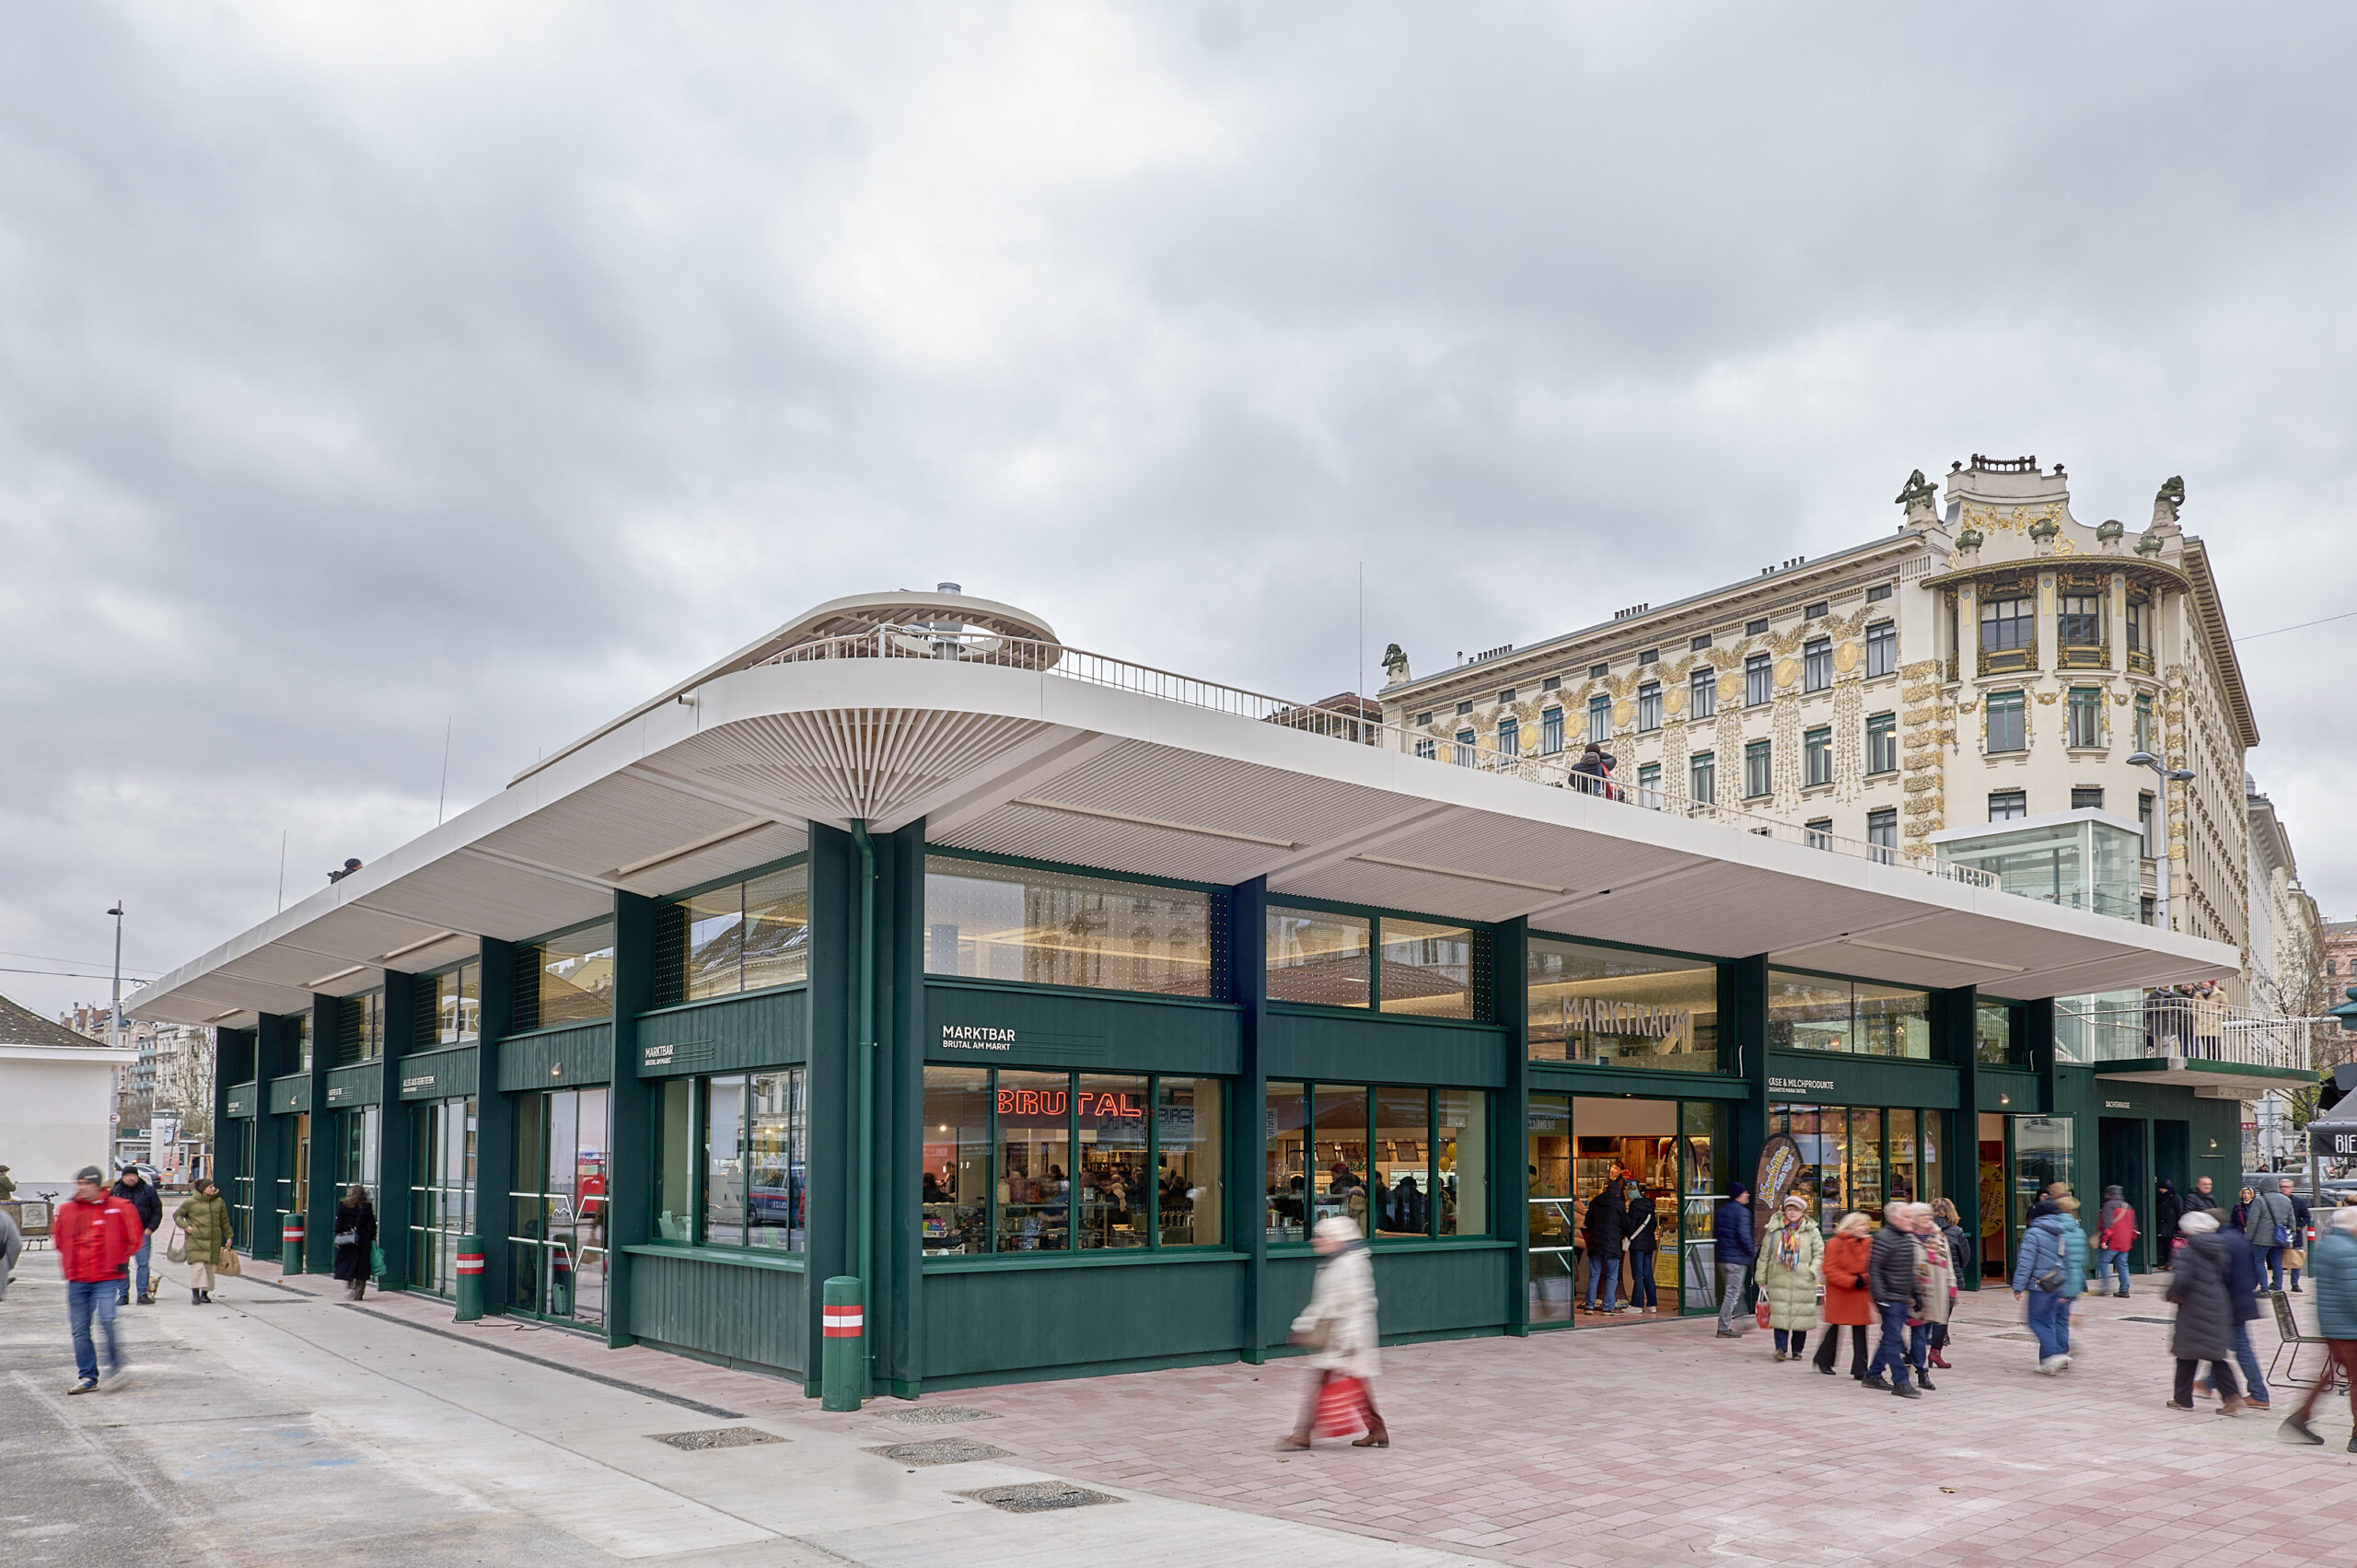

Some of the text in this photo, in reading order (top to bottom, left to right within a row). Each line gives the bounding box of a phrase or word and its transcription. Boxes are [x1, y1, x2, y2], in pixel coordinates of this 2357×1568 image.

[1562, 996, 1689, 1040] MARKTRAUM
[943, 1025, 1016, 1042] MARKTBAR
[645, 1045, 673, 1058] MARKTBAR
[943, 1040, 1011, 1051] BRUTAL AM MARKT
[1782, 1078, 1787, 1087] &
[1788, 1078, 1834, 1090] MILCHPRODUKTE
[997, 1089, 1142, 1117] BRUTAL
